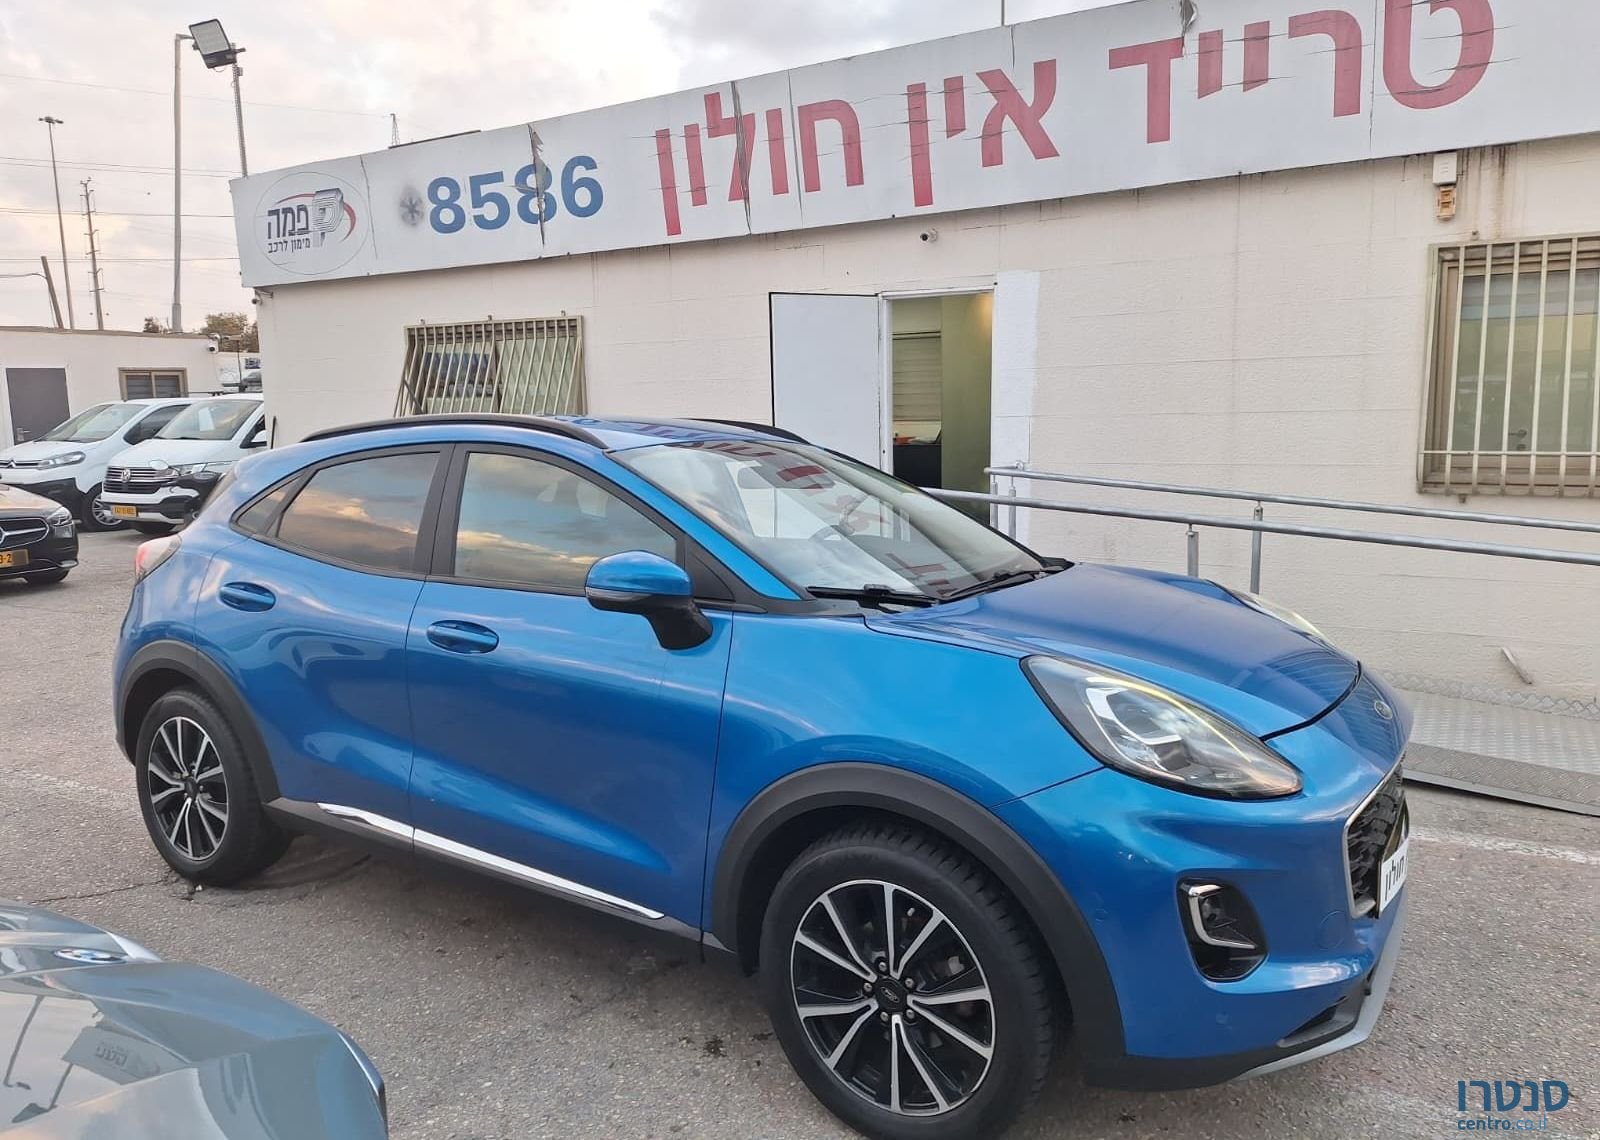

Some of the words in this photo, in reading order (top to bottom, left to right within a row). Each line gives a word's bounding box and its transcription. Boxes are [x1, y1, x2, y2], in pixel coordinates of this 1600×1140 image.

[1108, 0, 1495, 144] טרייד
[655, 91, 864, 236] חולון
[906, 58, 1060, 207] אין
[267, 204, 309, 240] פמה
[427, 155, 604, 234] 8586
[267, 240, 289, 254] לרכב
[291, 238, 311, 253] מימון
